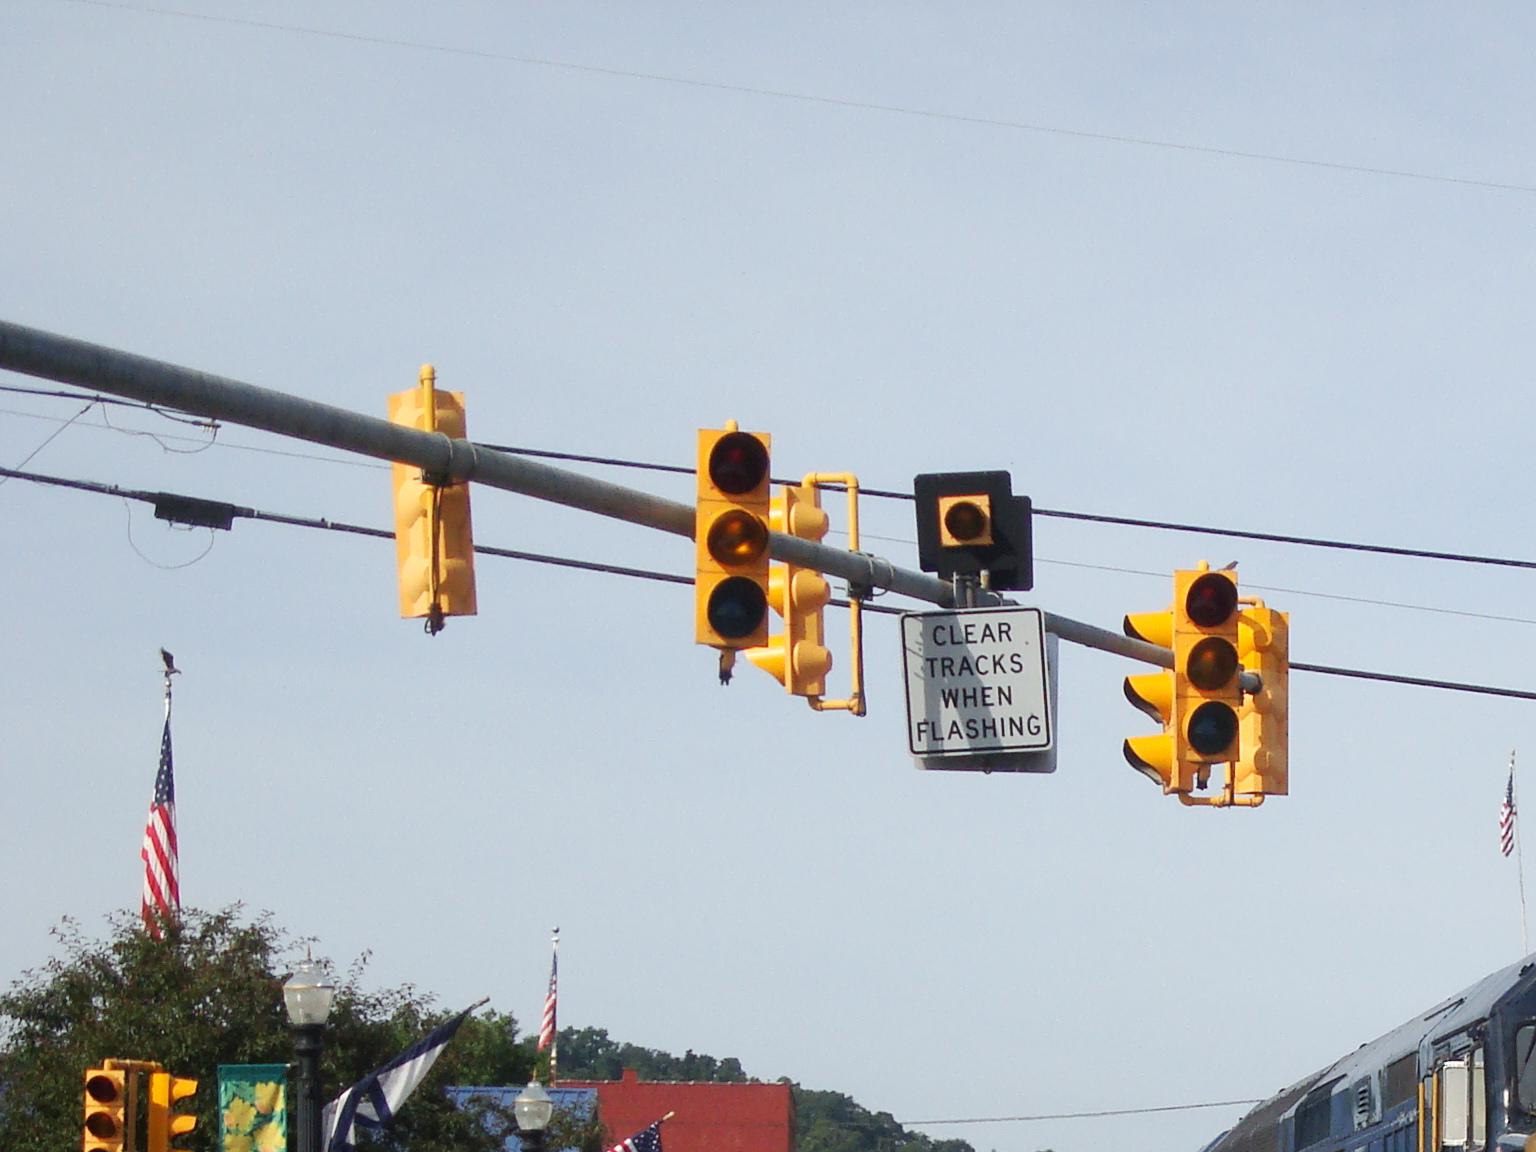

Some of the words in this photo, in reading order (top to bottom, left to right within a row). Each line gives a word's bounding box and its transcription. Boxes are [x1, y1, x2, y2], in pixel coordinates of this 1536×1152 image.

[932, 622, 1013, 647] CLEAR
[925, 653, 1023, 678] TRACKS
[941, 685, 1013, 709] WHEN
[917, 715, 1041, 742] FLASHING
